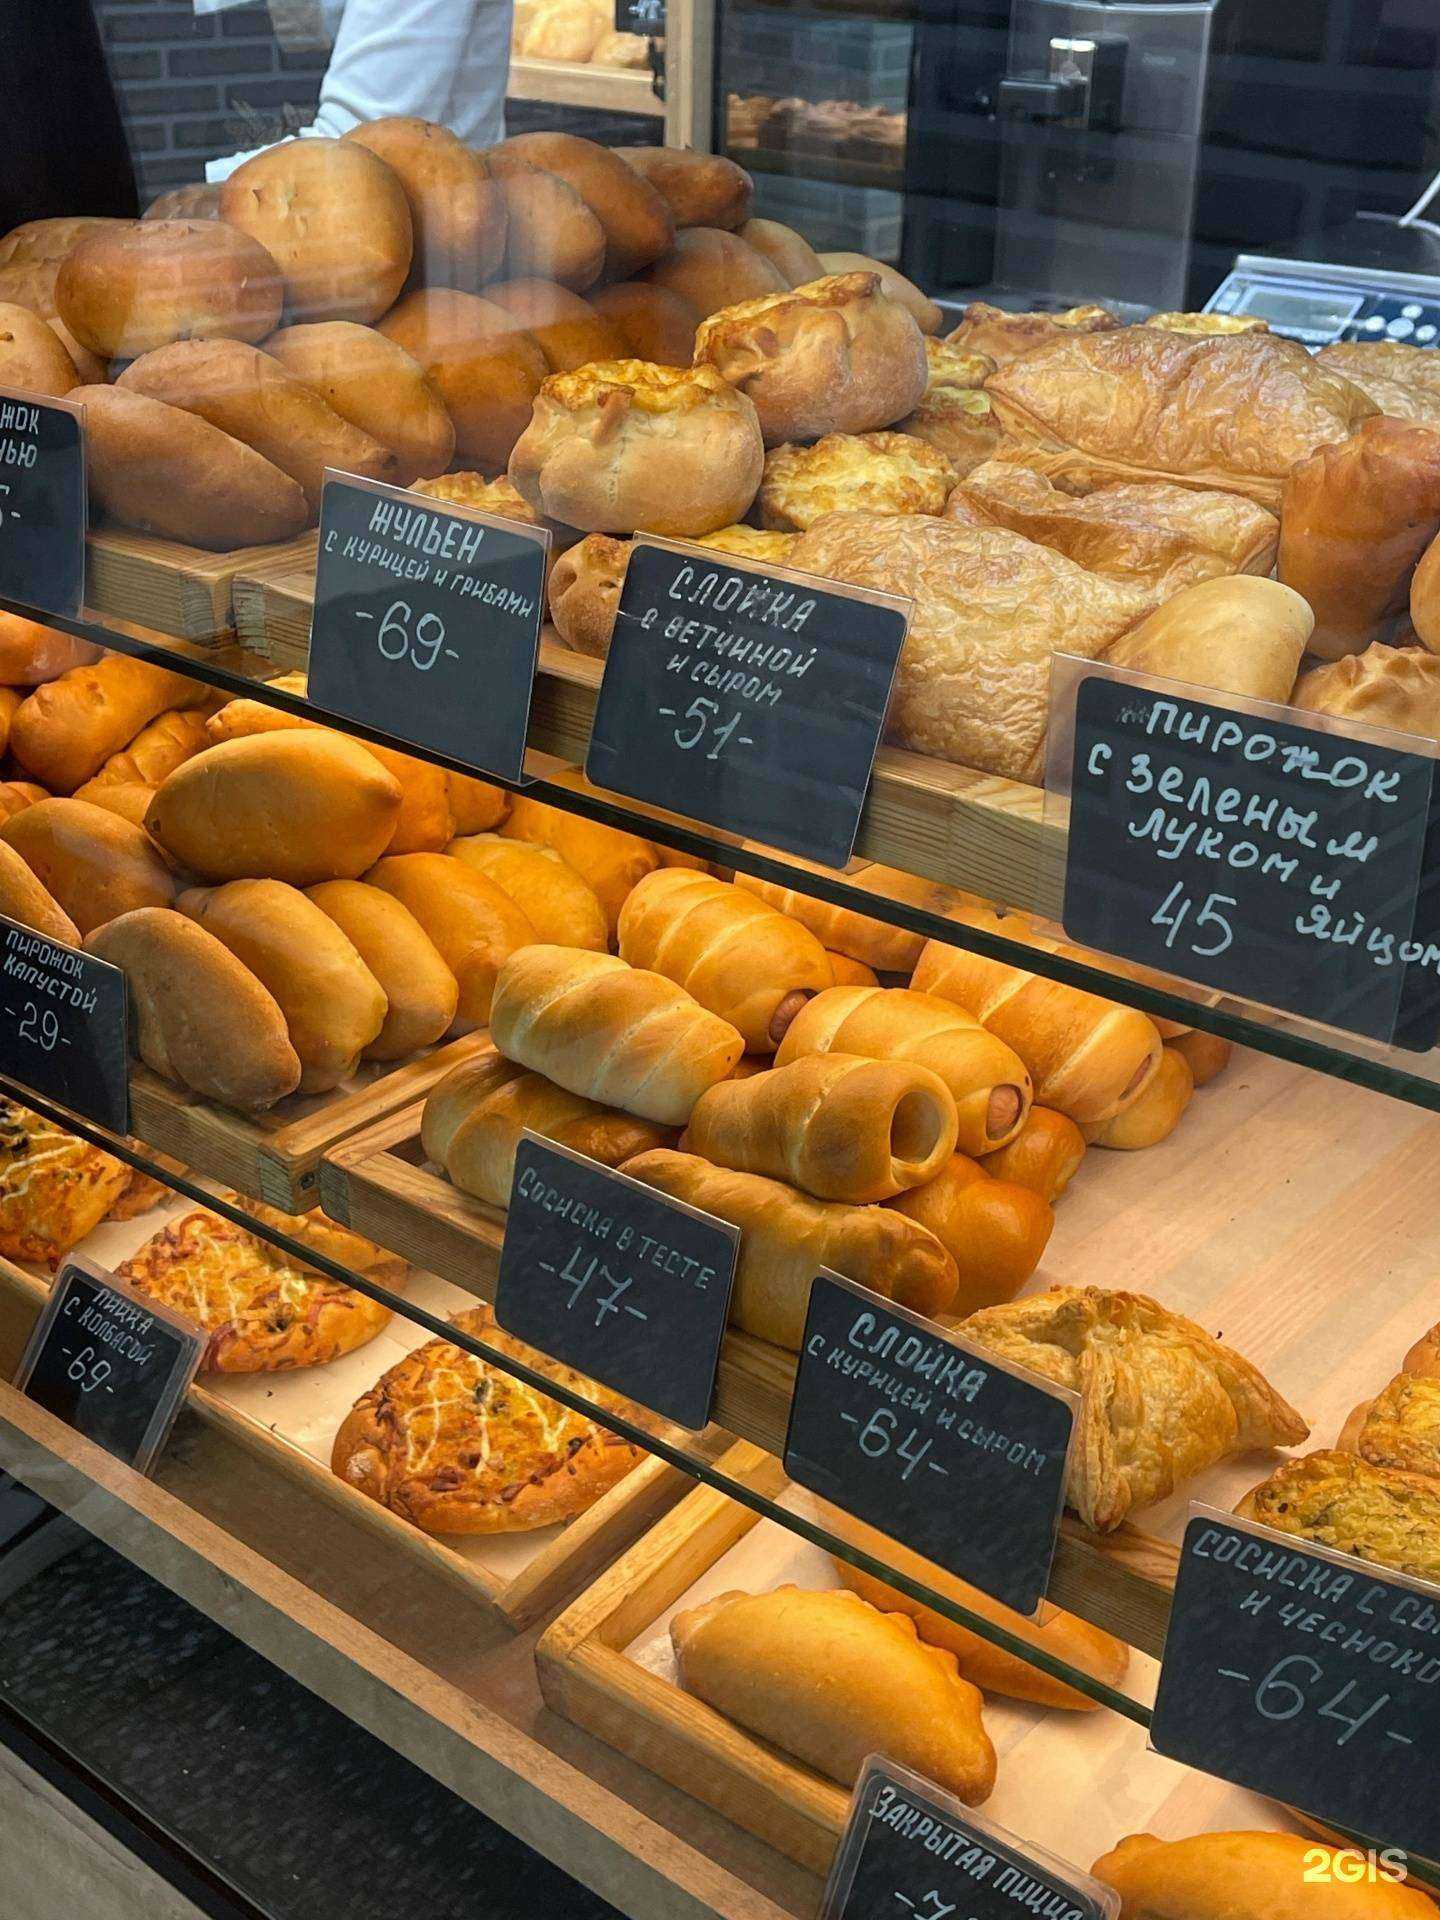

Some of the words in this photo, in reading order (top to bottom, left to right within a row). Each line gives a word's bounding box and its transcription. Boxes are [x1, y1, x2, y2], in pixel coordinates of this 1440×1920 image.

[369, 500, 485, 564] ЖУЛЬЕН
[325, 530, 338, 552] С
[343, 536, 430, 582] КУРИЦЕЙ
[432, 568, 448, 588] И
[450, 574, 534, 618] ГРИБАМИ
[668, 566, 818, 633] СЛОЙКА
[355, 601, 460, 671] -69-
[664, 615, 818, 678] ВЕТЧИНОЙ
[666, 653, 690, 674] И
[691, 659, 783, 706] СЫРОМ
[659, 697, 754, 760] -51-
[1150, 881, 1238, 956] 45
[3, 953, 98, 1014] КАПУСТОЙ
[5, 930, 85, 980] ПИРОЖОК
[4, 1002, 72, 1051] -29-
[517, 1167, 614, 1239] СОСИСКА
[616, 1226, 635, 1251] В
[637, 1235, 716, 1290] ТЕСТЕ
[538, 1246, 648, 1327] -47-
[63, 1297, 80, 1315] С
[78, 1306, 156, 1366] КОЛБАСОЙ
[848, 1312, 988, 1403] СЛОЙКА
[807, 1334, 826, 1356] С
[827, 1347, 933, 1415] КУРИЦЕЙ
[936, 1407, 957, 1430] И
[957, 1418, 1048, 1476] СЫРОМ
[840, 1407, 950, 1481] -64-
[1192, 1529, 1355, 1603] СОСИСКА
[1356, 1585, 1388, 1615] С
[1240, 1590, 1271, 1616] И
[1217, 1653, 1413, 1747] -64-
[868, 1786, 997, 1881] ЗАКРЫТАЯ
